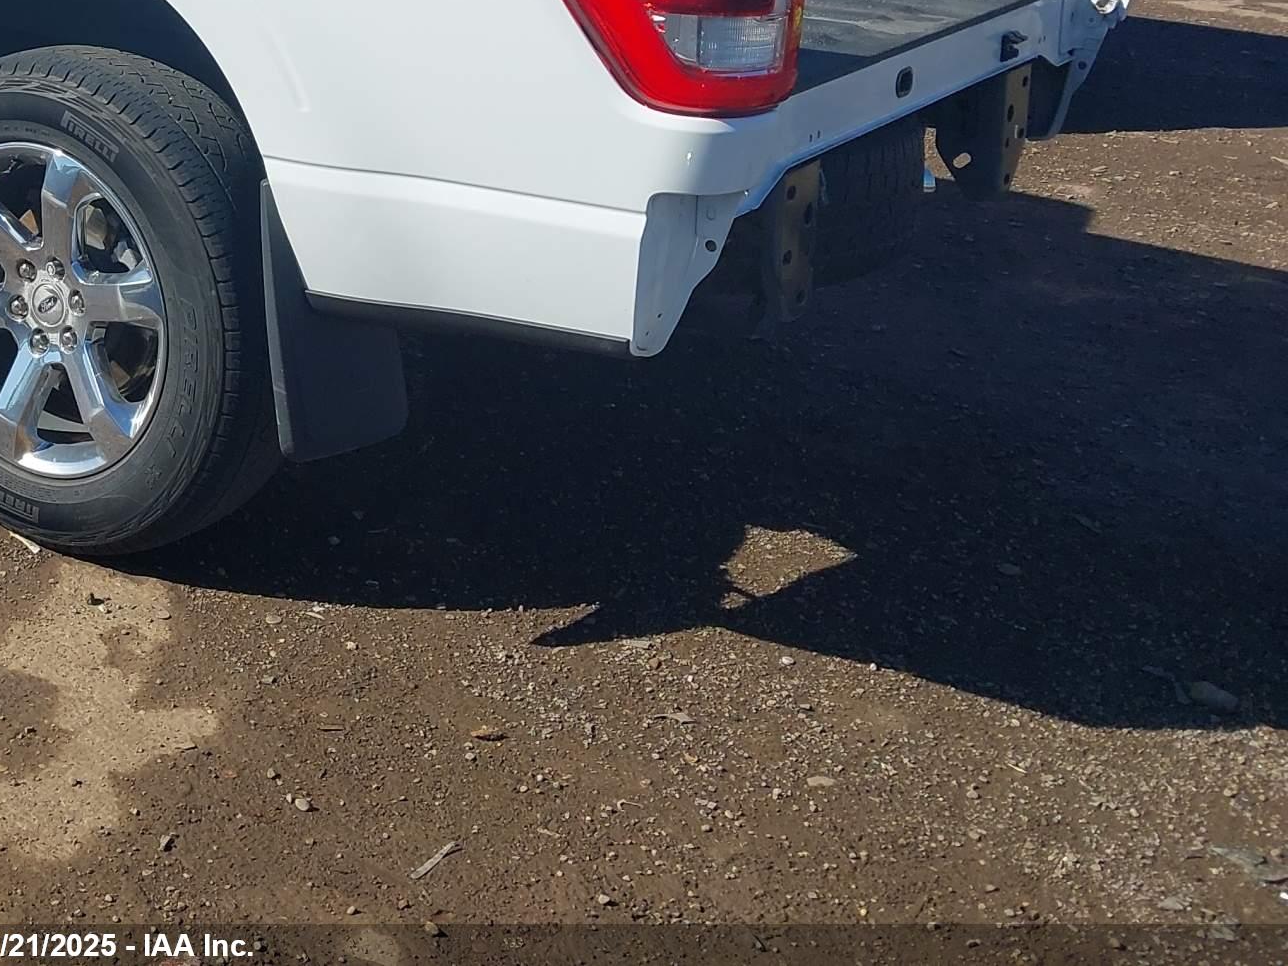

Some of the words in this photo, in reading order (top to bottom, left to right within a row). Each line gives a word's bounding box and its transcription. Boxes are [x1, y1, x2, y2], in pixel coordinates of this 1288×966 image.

[59, 109, 120, 163] PIRELLI
[39, 296, 56, 312] Ford
[168, 302, 200, 460] PIRELLI
